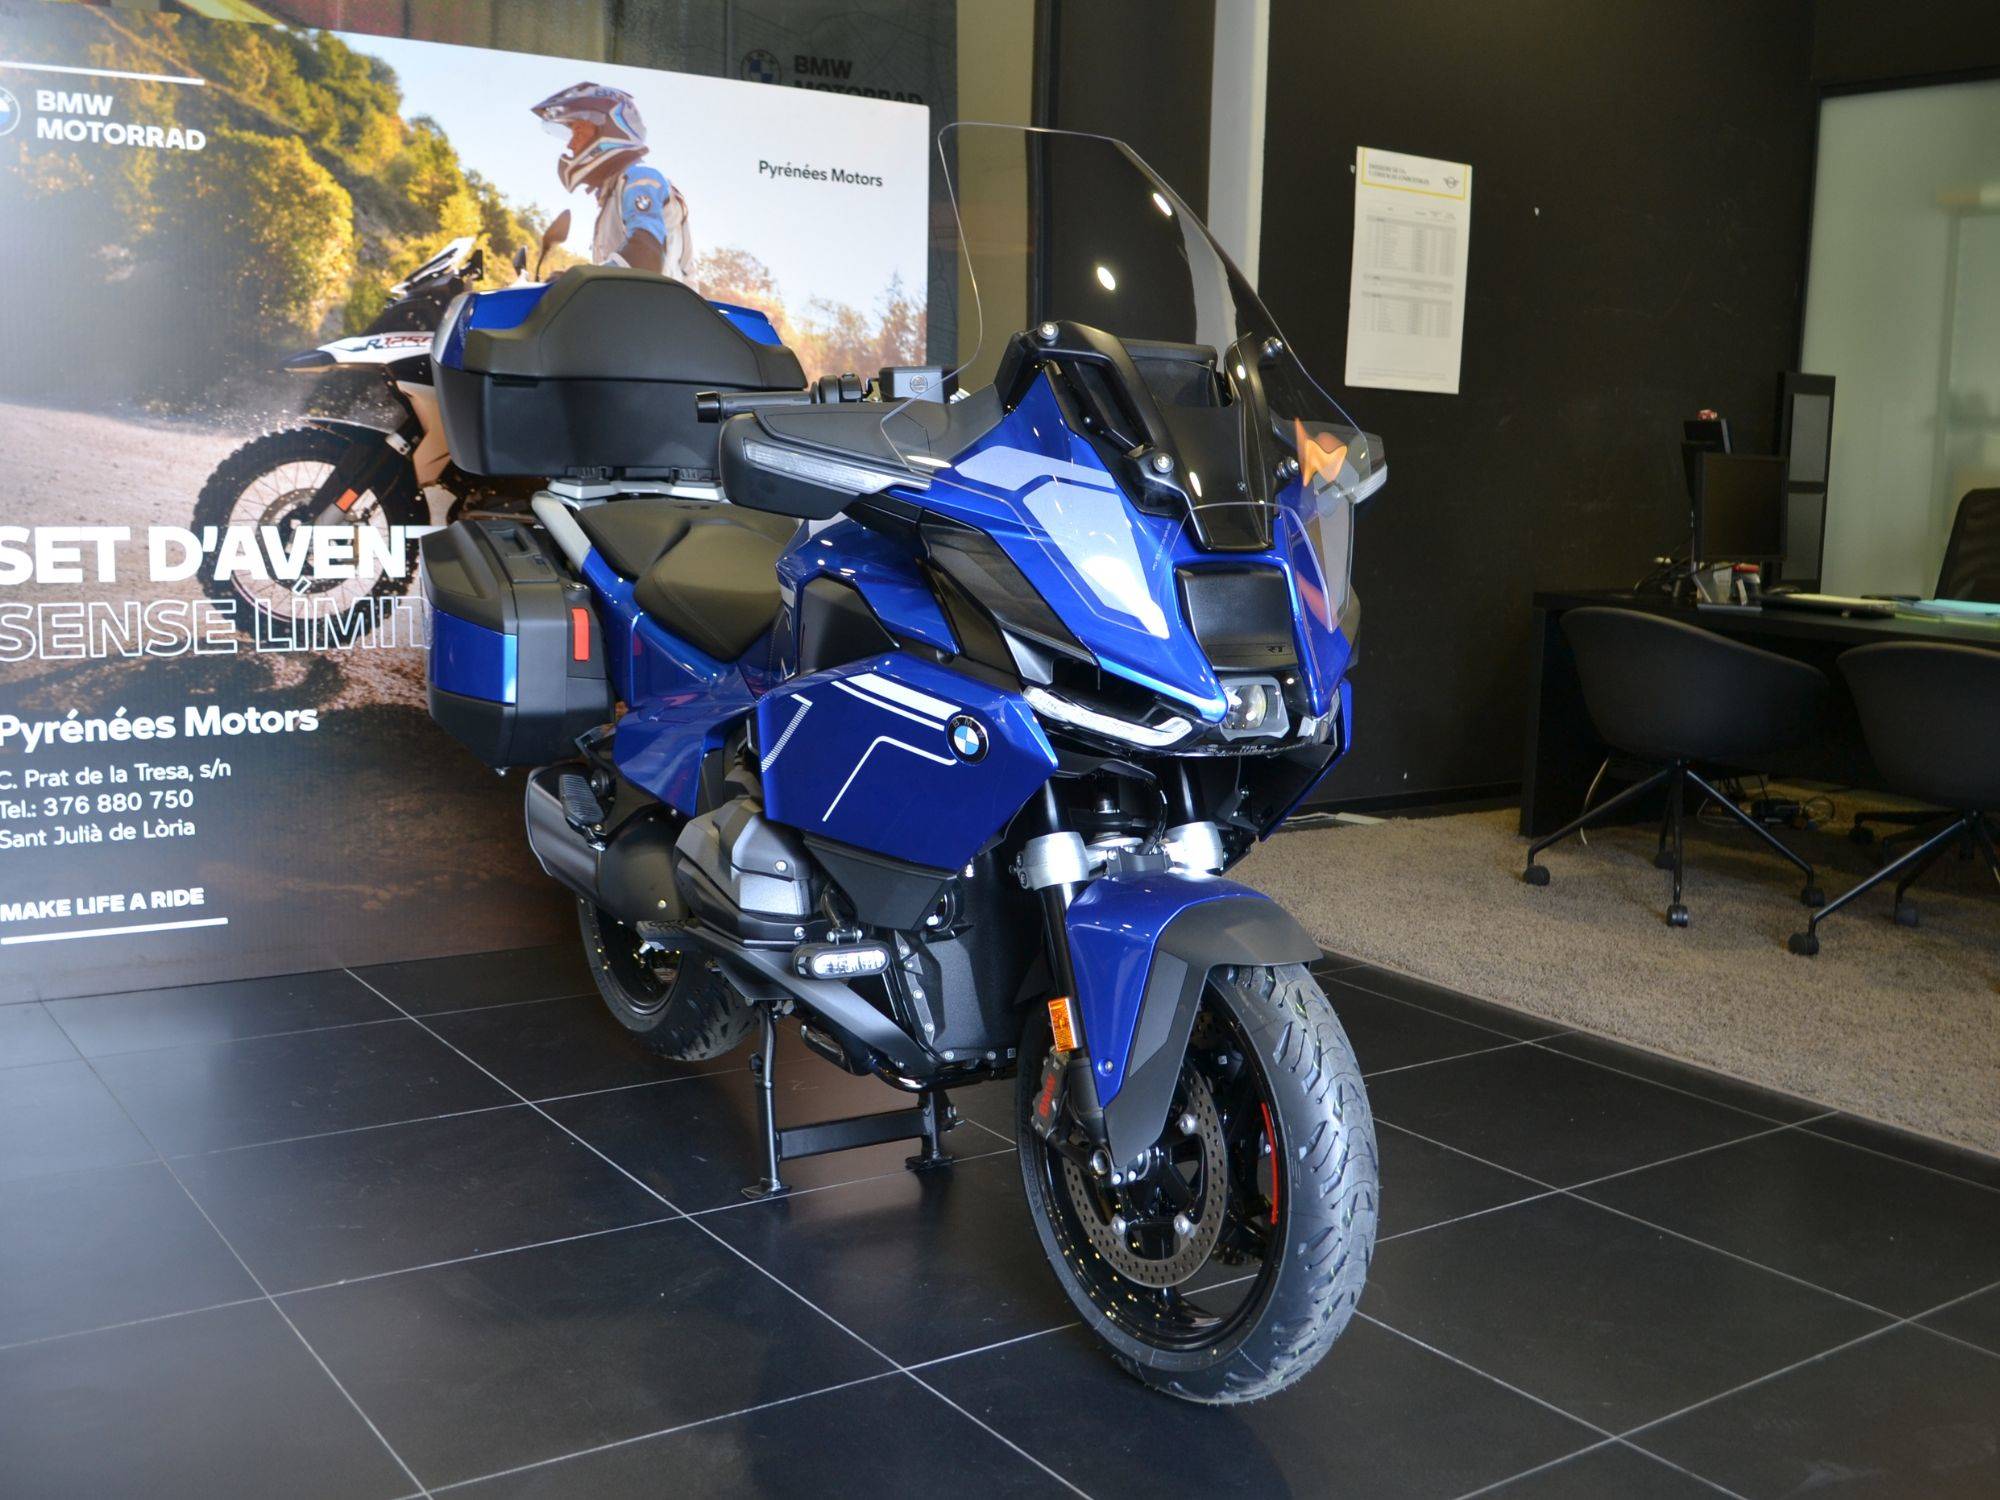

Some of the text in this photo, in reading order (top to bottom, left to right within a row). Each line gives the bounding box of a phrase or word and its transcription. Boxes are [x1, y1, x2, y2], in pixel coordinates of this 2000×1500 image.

[794, 55, 853, 79] BMW
[36, 89, 114, 117] BMW
[36, 118, 207, 151] MOTORRAD
[758, 160, 884, 187] Pyrénées Motors
[0, 526, 131, 585] SET
[0, 599, 238, 662] SENSE
[0, 705, 319, 753] Pyrénées Motors
[0, 758, 232, 790] C. Prat de la Tresa, s/n
[0, 789, 194, 819] Tel.: 376 880 750
[0, 819, 196, 849] Sant Julià de Lòria
[0, 887, 205, 922] MAKE LIFE A RIDE
